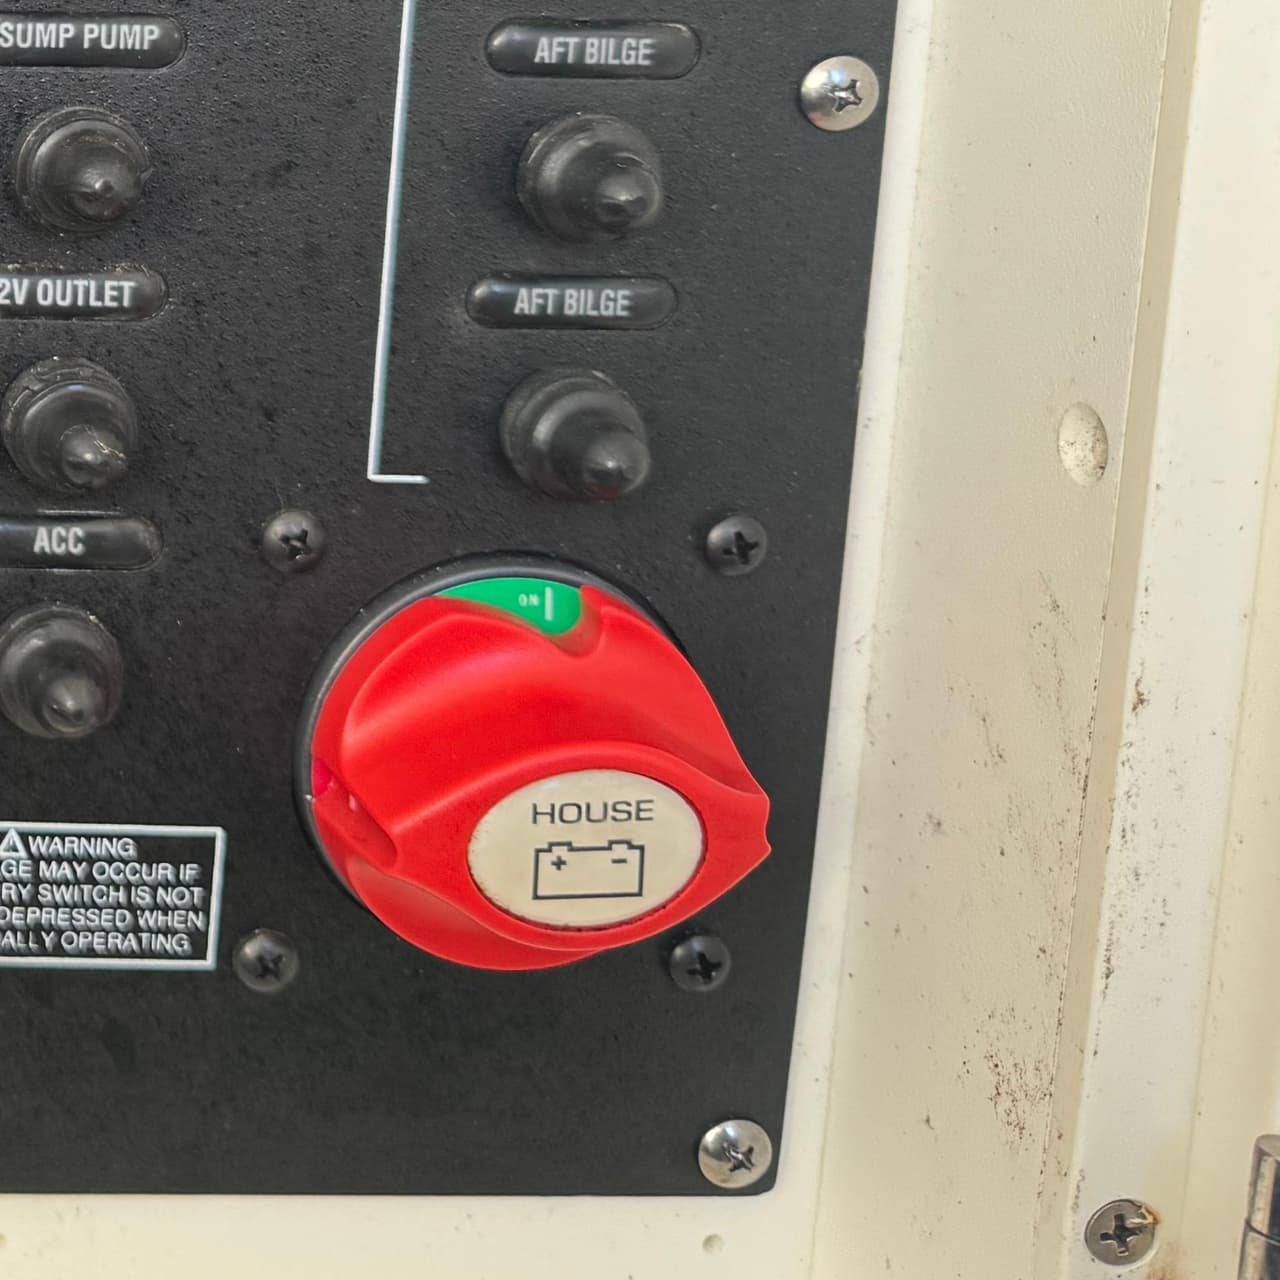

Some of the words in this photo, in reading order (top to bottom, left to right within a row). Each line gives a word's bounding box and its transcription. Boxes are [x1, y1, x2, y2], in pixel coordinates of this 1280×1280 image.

[83, 23, 161, 51] PUMP
[533, 36, 582, 65] AFT
[583, 37, 656, 67] BILGE
[35, 278, 137, 308] OUTLET
[513, 287, 561, 315] AFT
[563, 288, 632, 317] BILGE
[32, 526, 87, 556] ACC
[518, 594, 539, 608] ON
[531, 798, 656, 826] HOUSE
[28, 834, 138, 859] WARNING
[39, 860, 88, 882] MAY
[92, 861, 175, 884] OCCUR
[179, 863, 201, 884] IF
[37, 884, 126, 907] SWITCH
[131, 885, 151, 907] IS
[155, 886, 204, 908] NOT
[137, 909, 205, 933] WHEN
[60, 930, 192, 956] OPERATING
